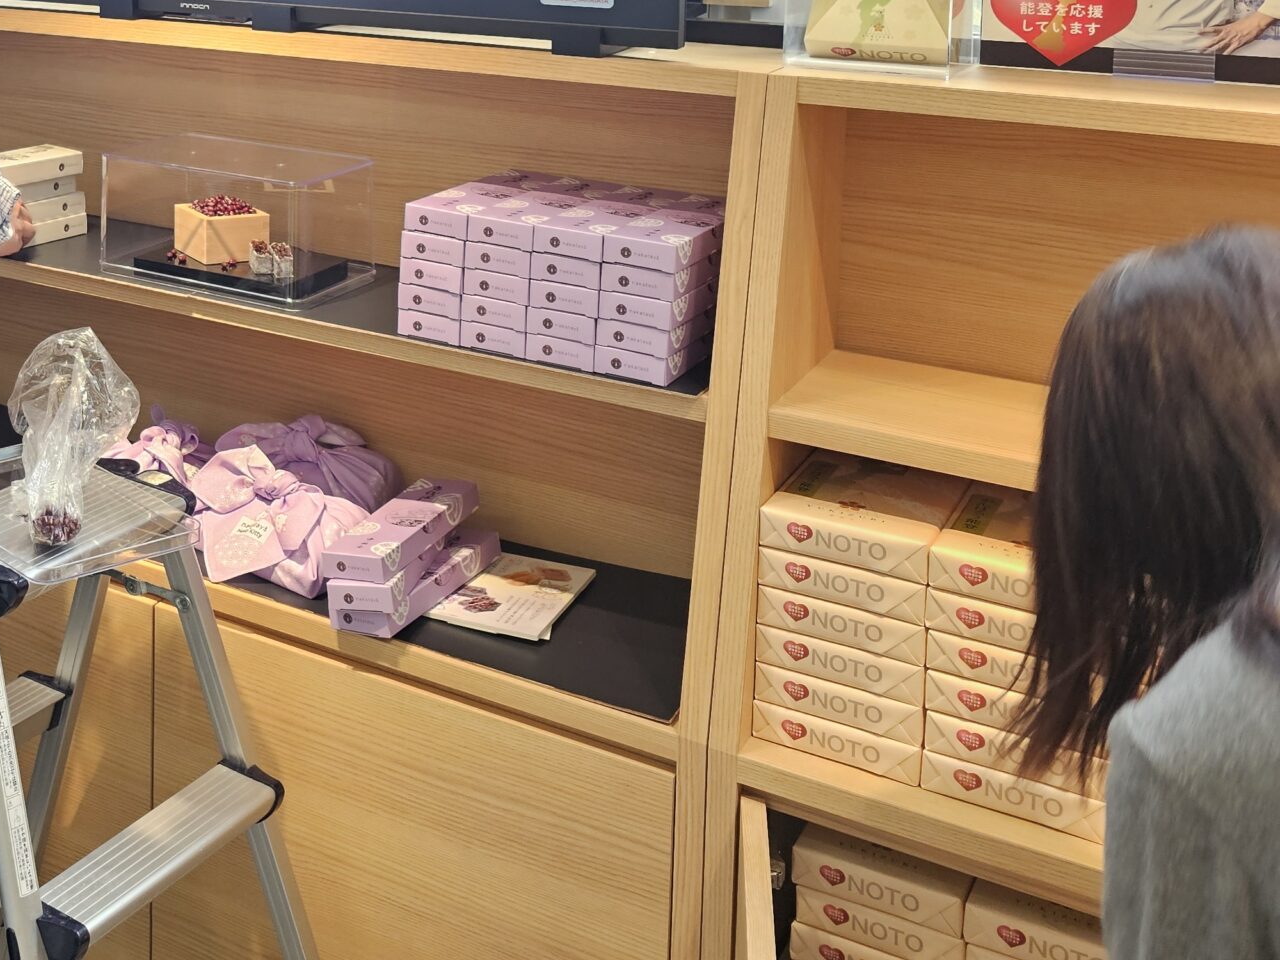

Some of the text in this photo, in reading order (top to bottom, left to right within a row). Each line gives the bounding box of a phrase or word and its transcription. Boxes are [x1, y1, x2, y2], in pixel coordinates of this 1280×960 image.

[1020, 1, 1104, 19] 能登を応援
[1022, 19, 1101, 36] しています
[859, 49, 927, 62] NOTO
[815, 529, 887, 561] NOTO
[812, 569, 885, 602] NOTO
[990, 572, 1032, 598] NO
[811, 609, 884, 643] NOTO
[811, 649, 883, 683] NOTO
[811, 689, 883, 723] NOTO
[809, 729, 880, 764] NOTO
[984, 779, 1064, 818] NOTO
[847, 874, 920, 912] NOTO
[851, 913, 924, 953] NOTO
